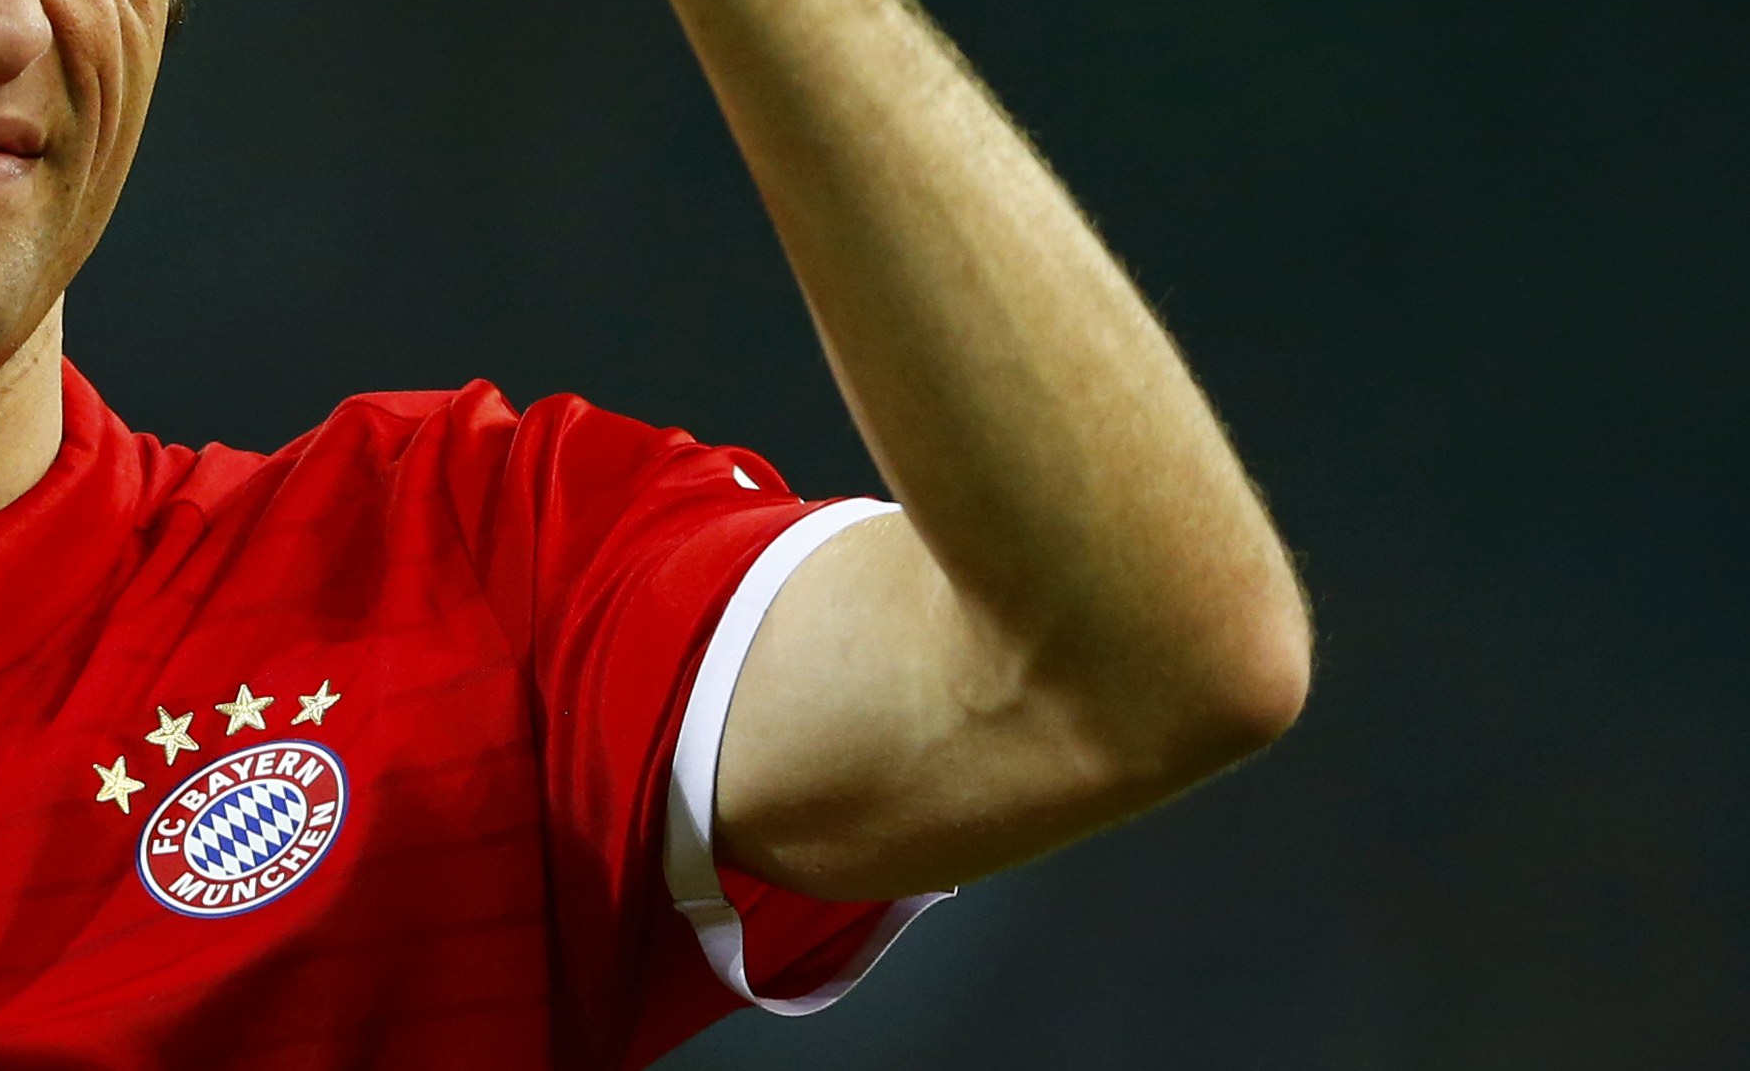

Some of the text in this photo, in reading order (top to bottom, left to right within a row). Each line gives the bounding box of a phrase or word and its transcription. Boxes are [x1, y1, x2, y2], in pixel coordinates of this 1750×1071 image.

[152, 751, 324, 855] FC BAYERN
[168, 800, 336, 906] MÜNCHEN
